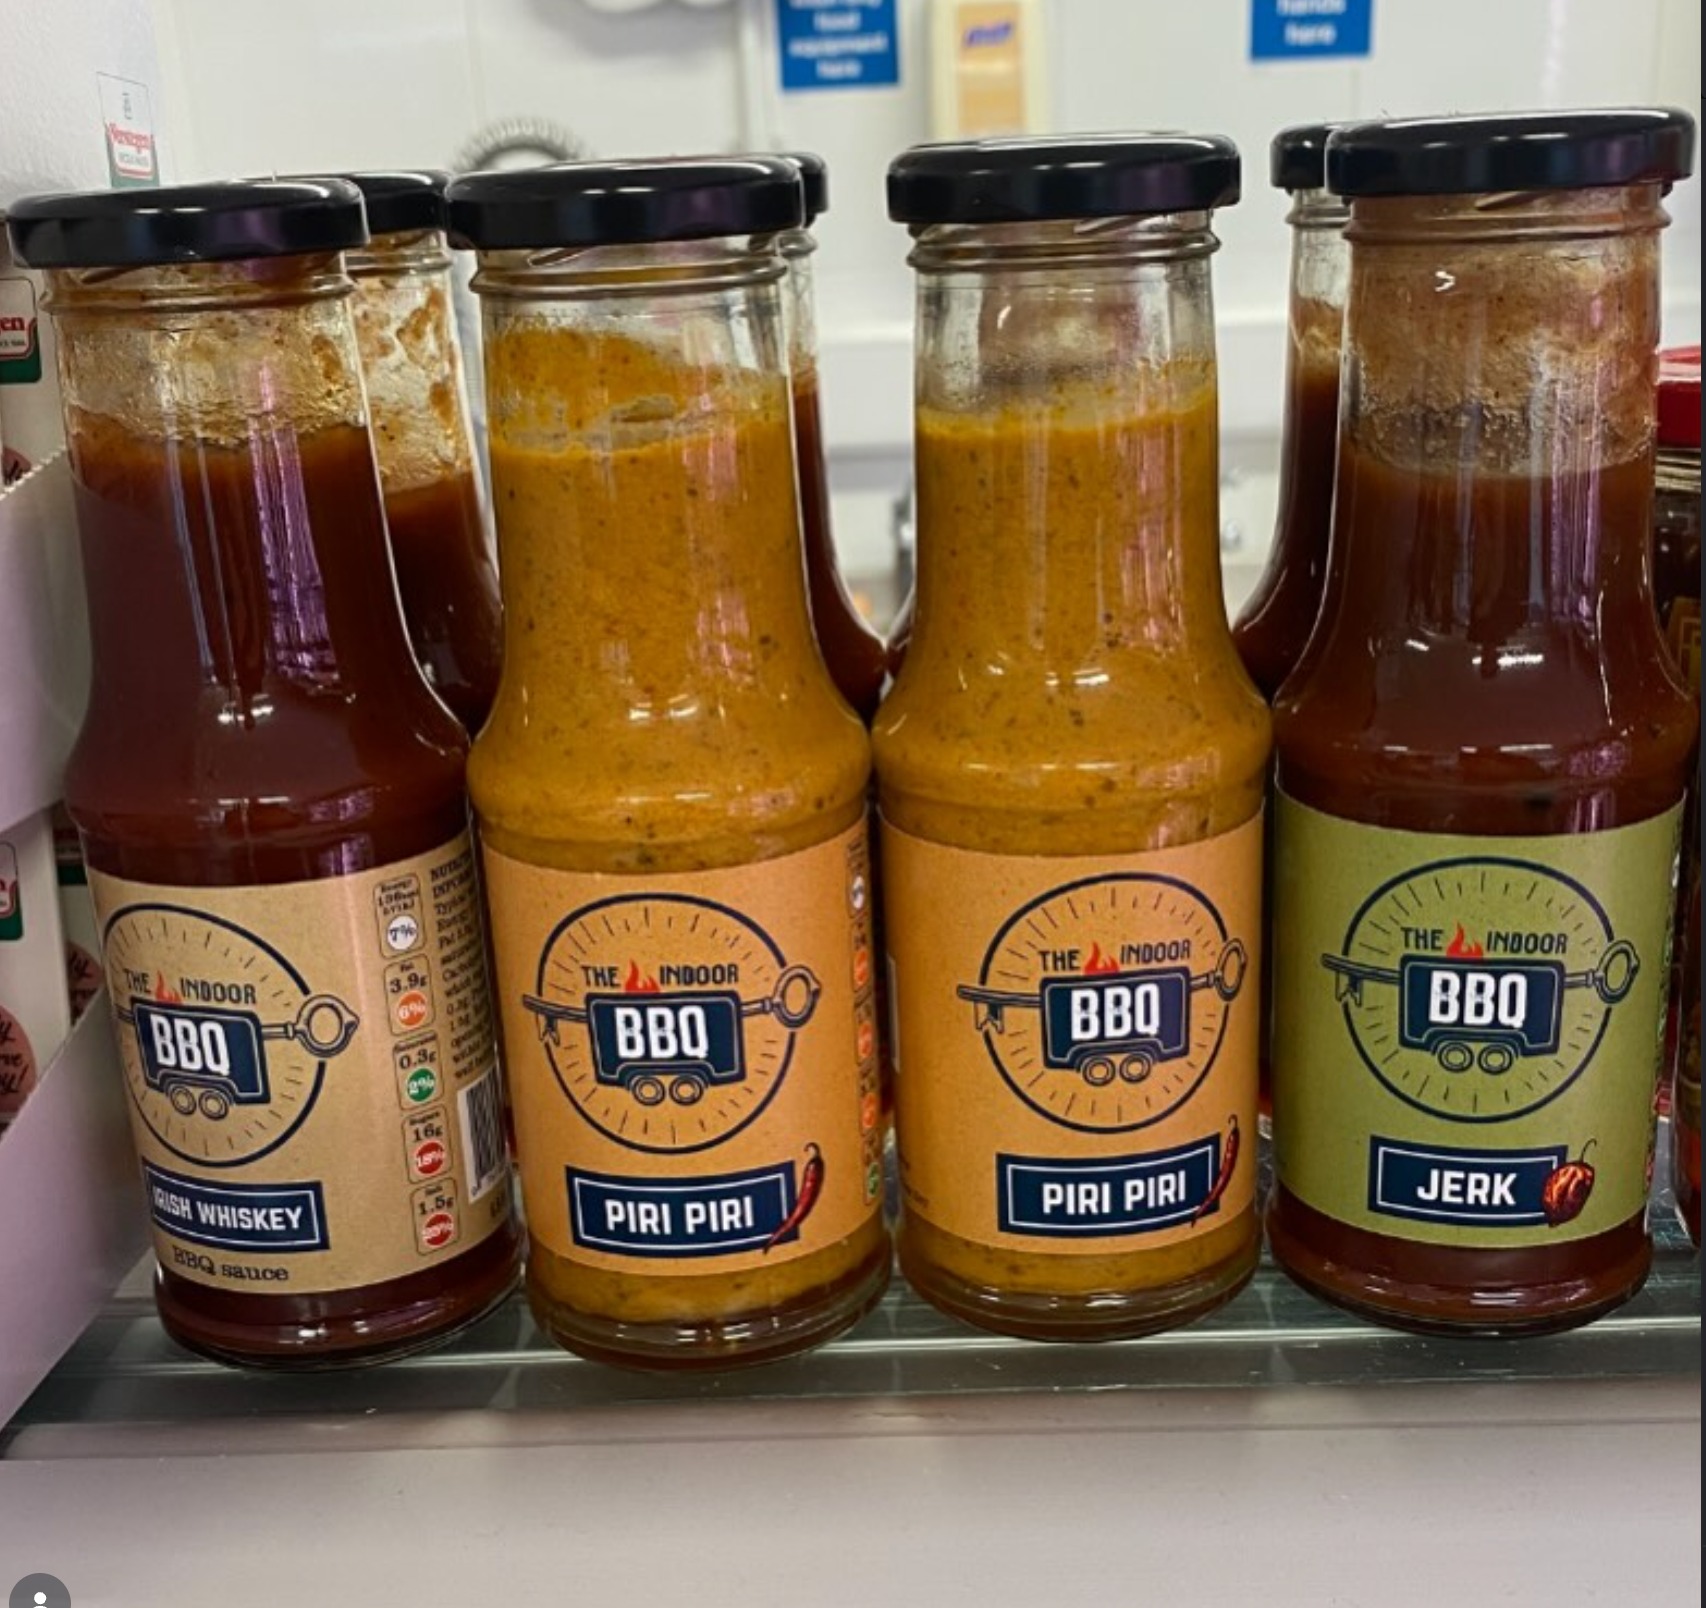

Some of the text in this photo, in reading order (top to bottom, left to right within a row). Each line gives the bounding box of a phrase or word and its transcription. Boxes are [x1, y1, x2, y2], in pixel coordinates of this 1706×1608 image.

[390, 923, 416, 941] 7%
[1401, 927, 1568, 954] THE INDOOR
[1038, 939, 1192, 972] THE INDOOR
[124, 968, 256, 1004] THE INDOOR
[390, 972, 428, 993] 3.9g
[582, 964, 739, 988] THE INDOOR
[1071, 983, 1160, 1041] BBQ
[1429, 970, 1527, 1028] BBQ
[150, 1013, 230, 1076] BBQ
[615, 1005, 709, 1060] BBQ
[400, 1048, 436, 1069] 0.3g
[409, 1075, 434, 1095] 2%
[1043, 1170, 1186, 1216] PIRI PIRI
[1417, 1169, 1517, 1206] JERK
[153, 1185, 303, 1231] IRISH WHISKEY
[605, 1196, 754, 1235] PIRI PIRI
[172, 1245, 289, 1281] BBQ sauce
